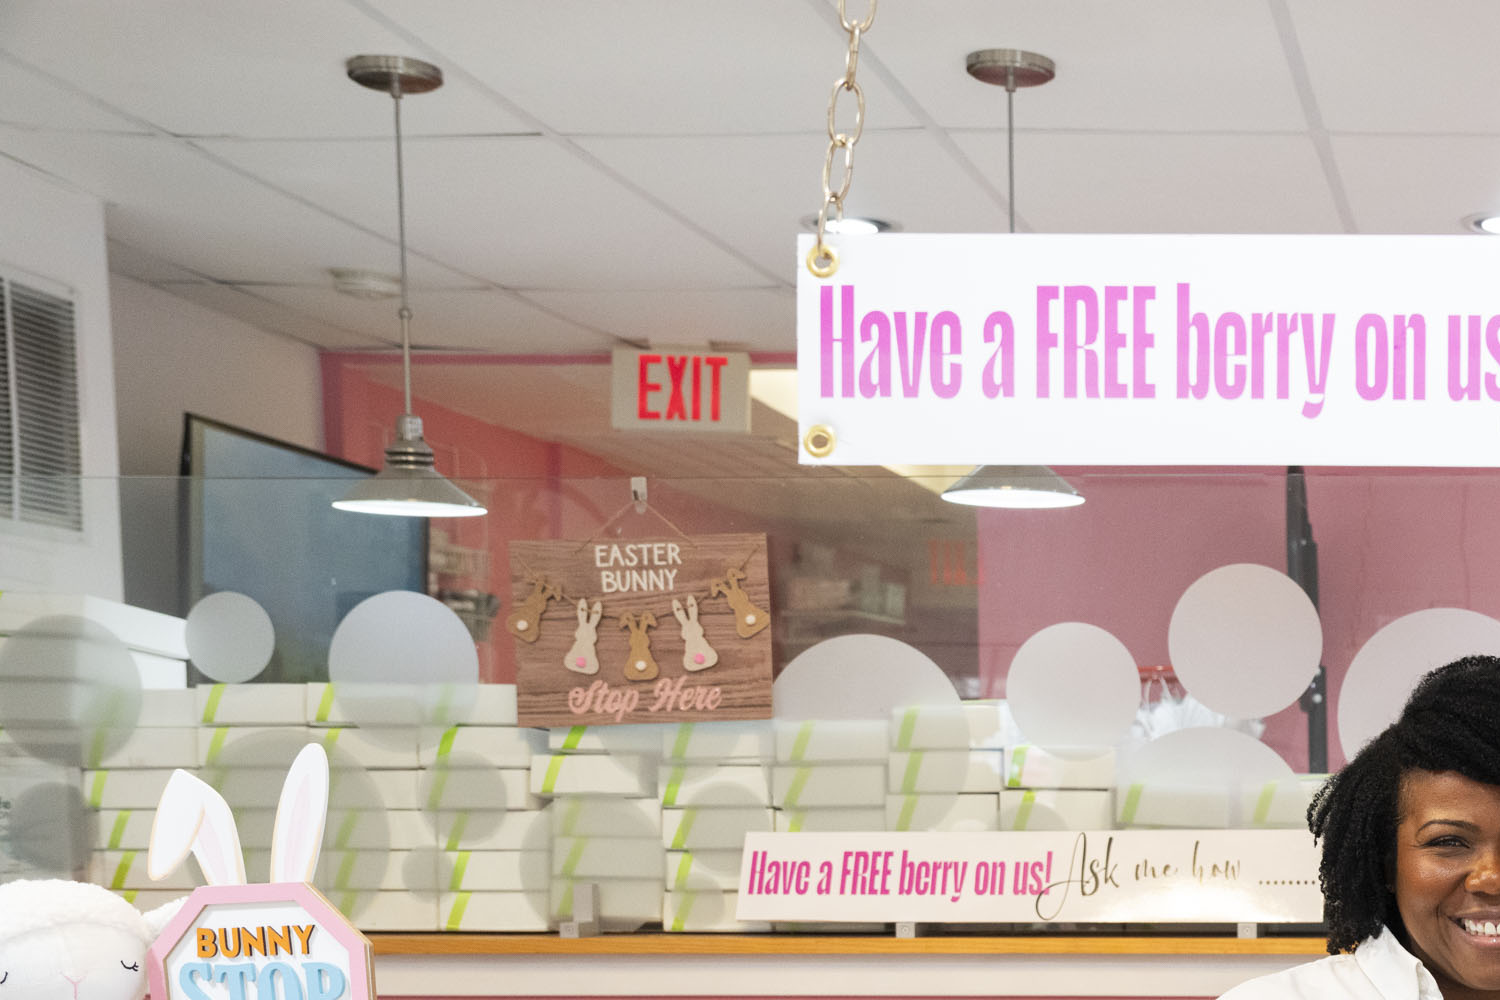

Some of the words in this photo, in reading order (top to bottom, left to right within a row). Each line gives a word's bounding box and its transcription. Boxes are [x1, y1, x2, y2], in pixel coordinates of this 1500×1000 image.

[820, 285, 962, 399] Have
[982, 310, 1015, 399] a
[1036, 285, 1156, 399] FREE
[1176, 282, 1336, 419] berry
[1354, 312, 1426, 401] on
[637, 354, 729, 421] EXIT
[594, 543, 682, 568] EASTER
[601, 568, 678, 593] BUNNY
[568, 680, 640, 722] Stop
[648, 675, 722, 712] Here
[748, 850, 811, 895] Have
[816, 860, 833, 895] a
[839, 851, 894, 895] FREE
[898, 850, 968, 902] berry
[974, 861, 1006, 895] on
[1013, 851, 1053, 896] us!
[1036, 832, 1119, 921] Ask
[1135, 859, 1178, 881] me
[196, 924, 316, 958] BUNNY
